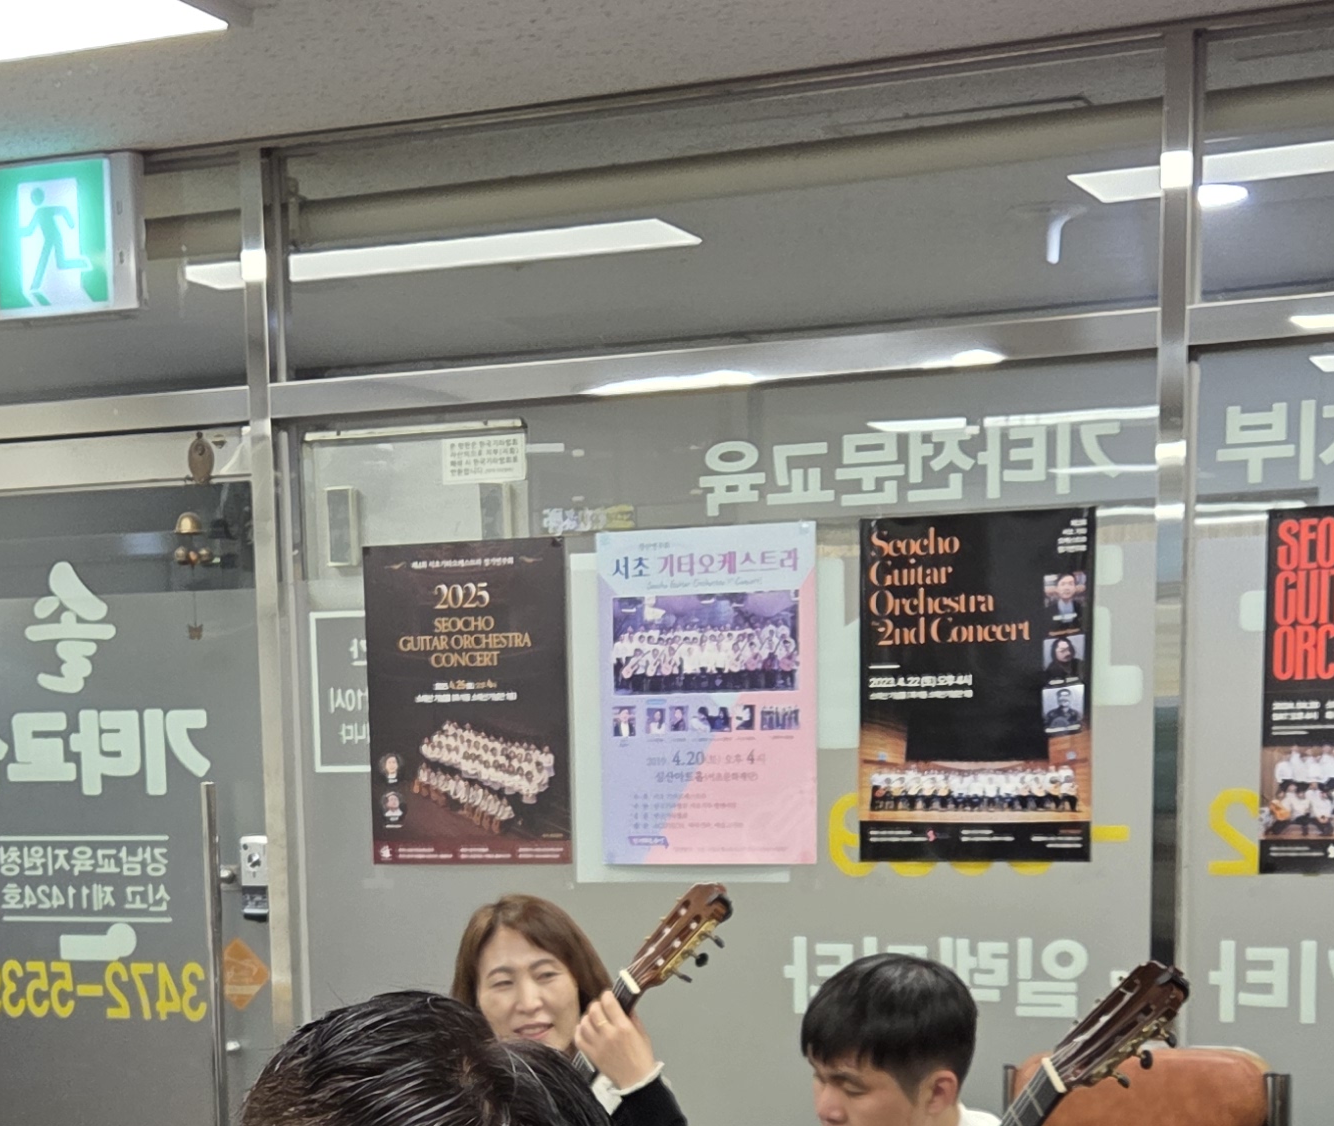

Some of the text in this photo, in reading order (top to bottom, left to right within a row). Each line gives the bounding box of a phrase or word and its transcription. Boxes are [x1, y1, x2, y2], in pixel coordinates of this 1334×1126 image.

[870, 527, 961, 558] Seocho
[612, 547, 799, 580] 서초 기타오케스트라
[870, 558, 954, 588] Guitar
[434, 582, 490, 610] 2025
[869, 588, 995, 617] Orchestra
[434, 616, 495, 633] SEOCHO
[877, 617, 1031, 646] 2nd Concert
[398, 632, 532, 651] GUITAR ORCHESTRA
[431, 651, 501, 668] CONCERT
